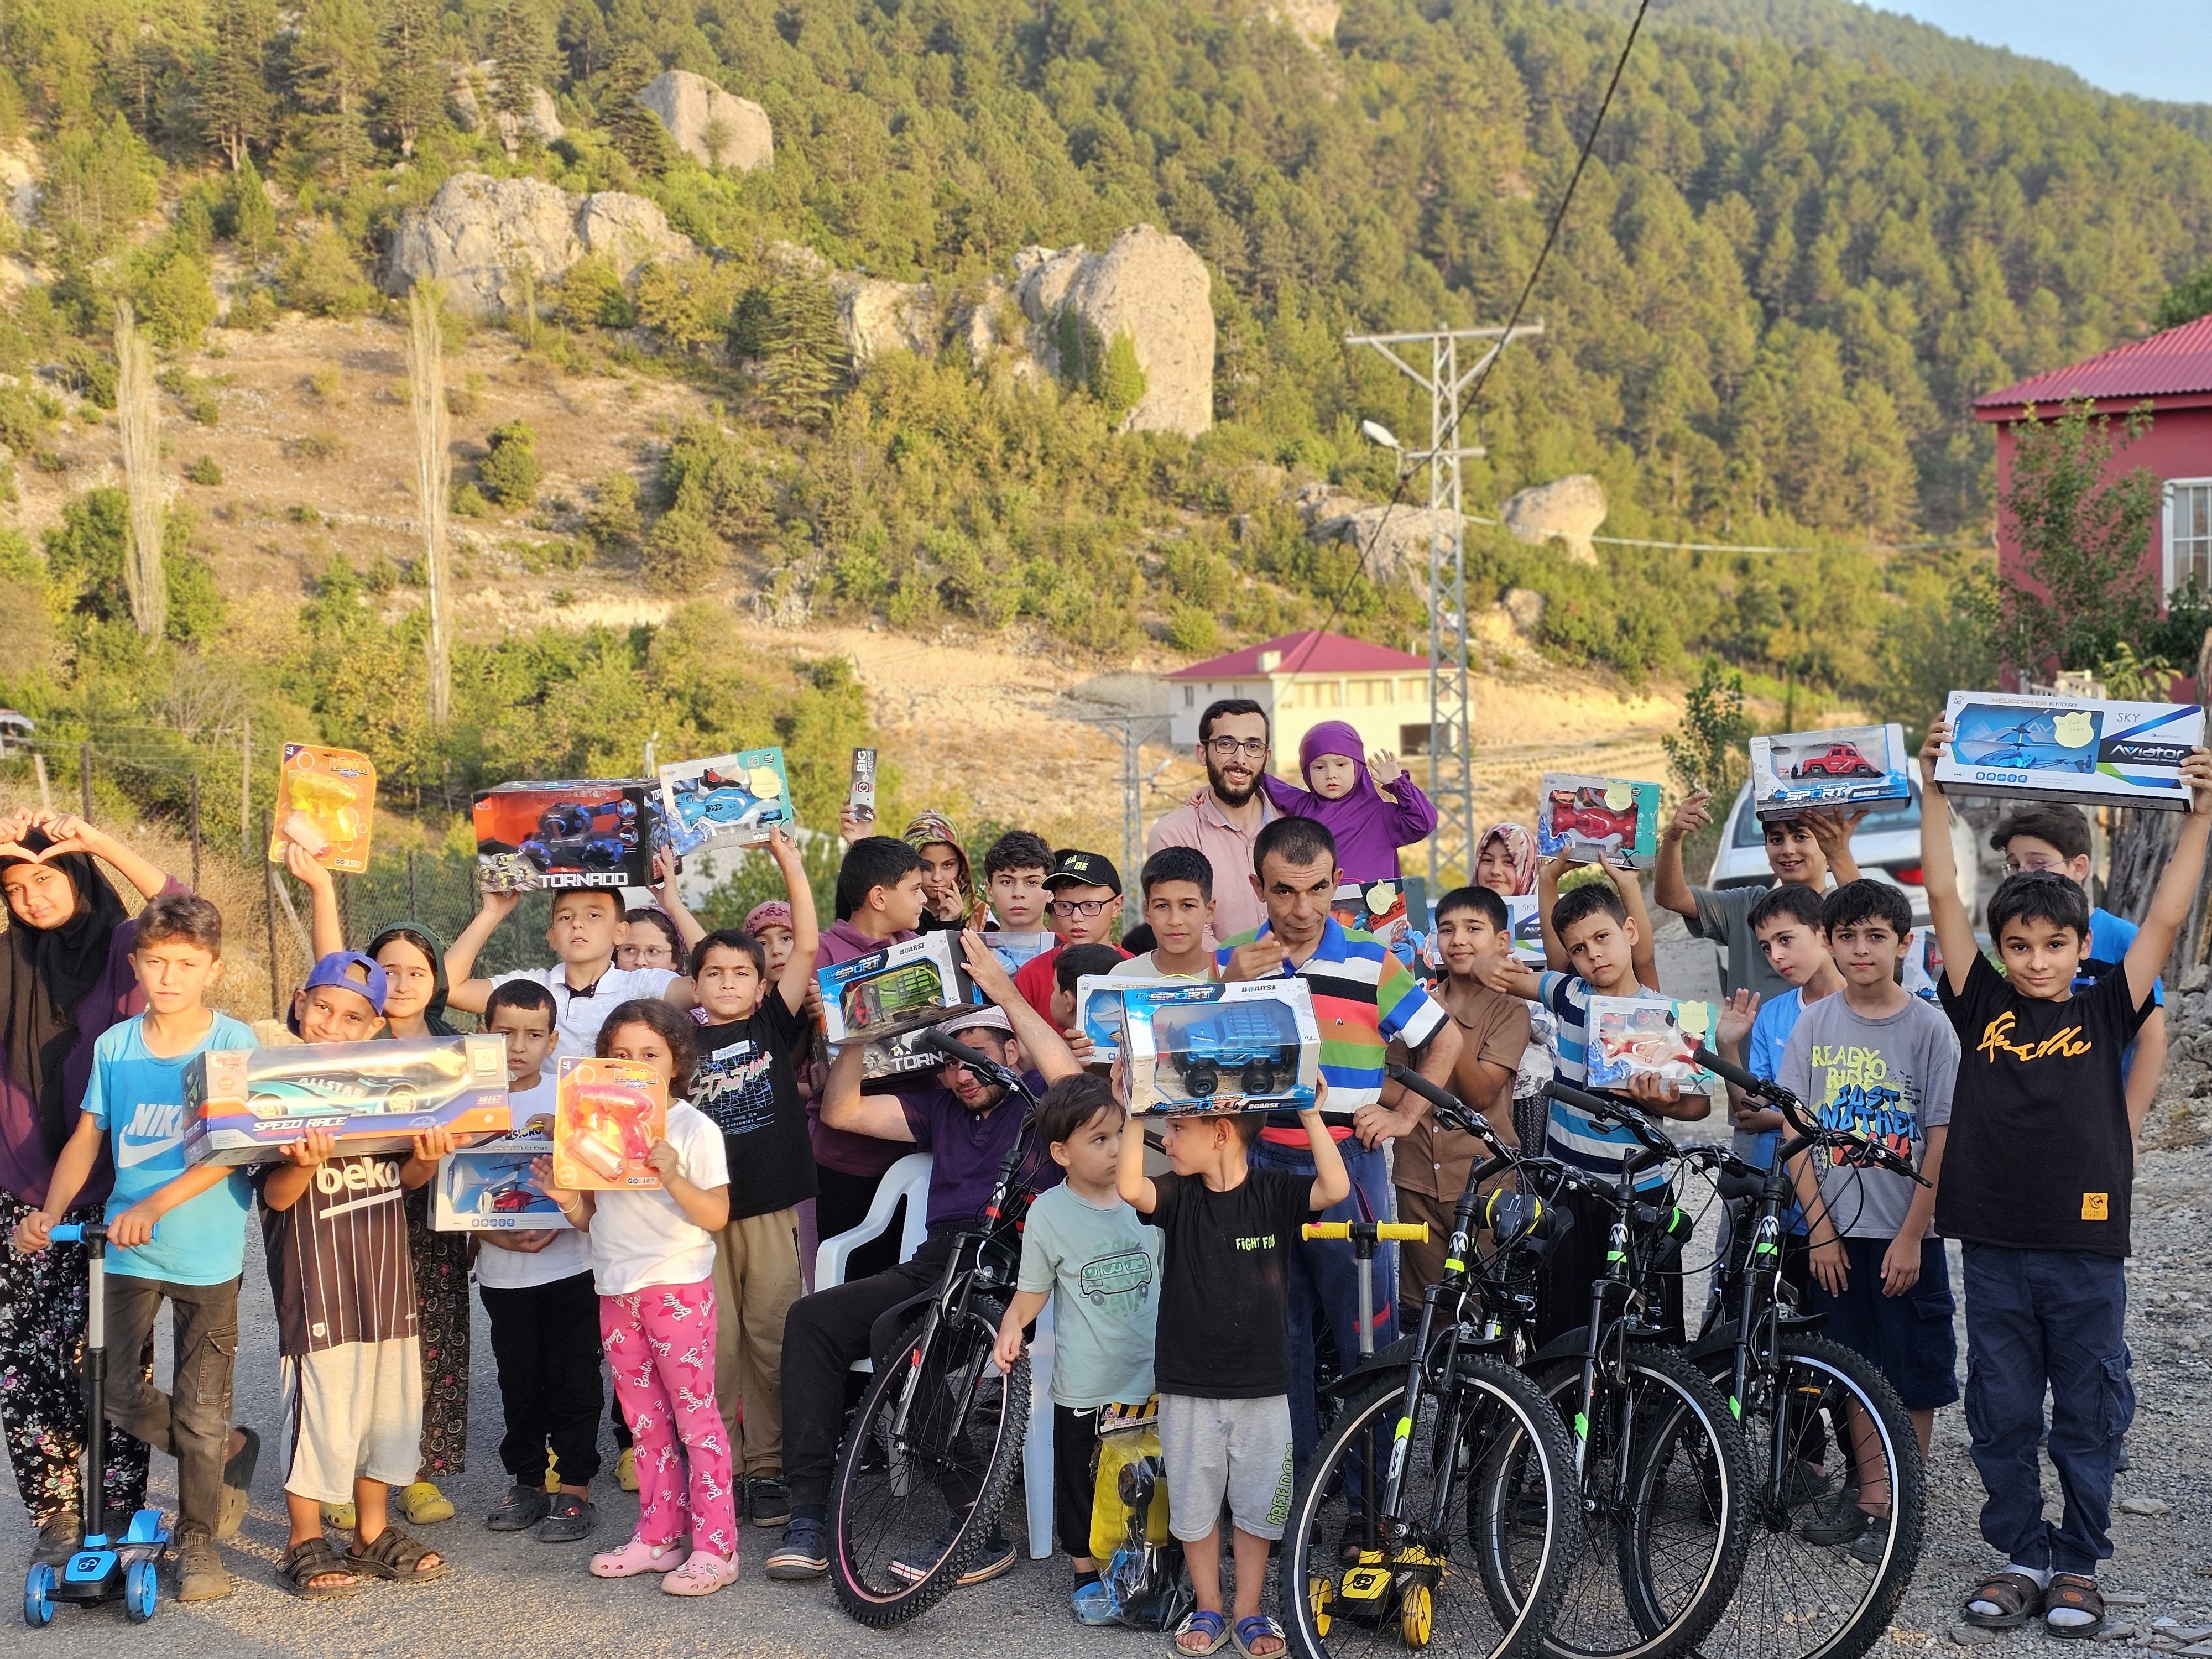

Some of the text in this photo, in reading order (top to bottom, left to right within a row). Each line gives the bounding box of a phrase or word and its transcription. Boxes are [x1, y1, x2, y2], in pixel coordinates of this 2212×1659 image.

[2117, 712, 2140, 723] SKY
[857, 750, 867, 772] BIG
[1784, 787, 1846, 801] SPORT
[1065, 854, 1092, 865] GAME
[538, 872, 628, 888] TORNADO
[900, 942, 925, 956] BOARSE
[1147, 990, 1212, 1001] SPORT
[1166, 1099, 1240, 1113] SPORT
[1833, 1083, 1901, 1114] JUST
[252, 1116, 348, 1132] SPEED RACE
[316, 1157, 400, 1194] beko
[662, 1292, 693, 1321] Barbie
[679, 1386, 703, 1413] Barbie
[701, 1470, 723, 1501] Barbie
